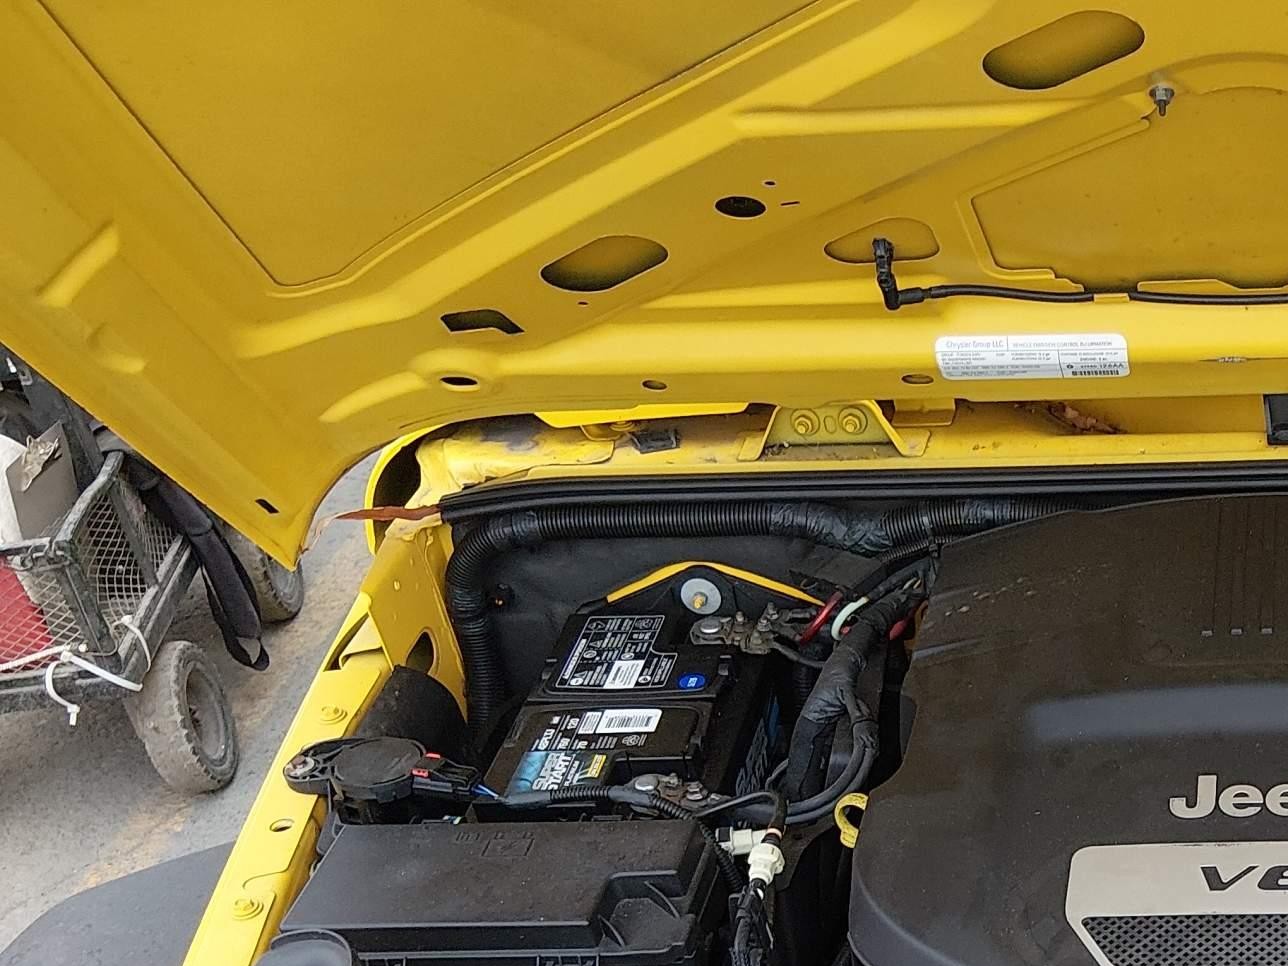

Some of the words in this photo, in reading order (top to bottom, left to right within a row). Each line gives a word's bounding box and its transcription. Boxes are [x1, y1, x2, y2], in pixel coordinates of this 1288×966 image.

[973, 341, 991, 349] Group
[992, 340, 1004, 348] LLC
[532, 752, 562, 790] SUPER
[547, 754, 572, 790] START
